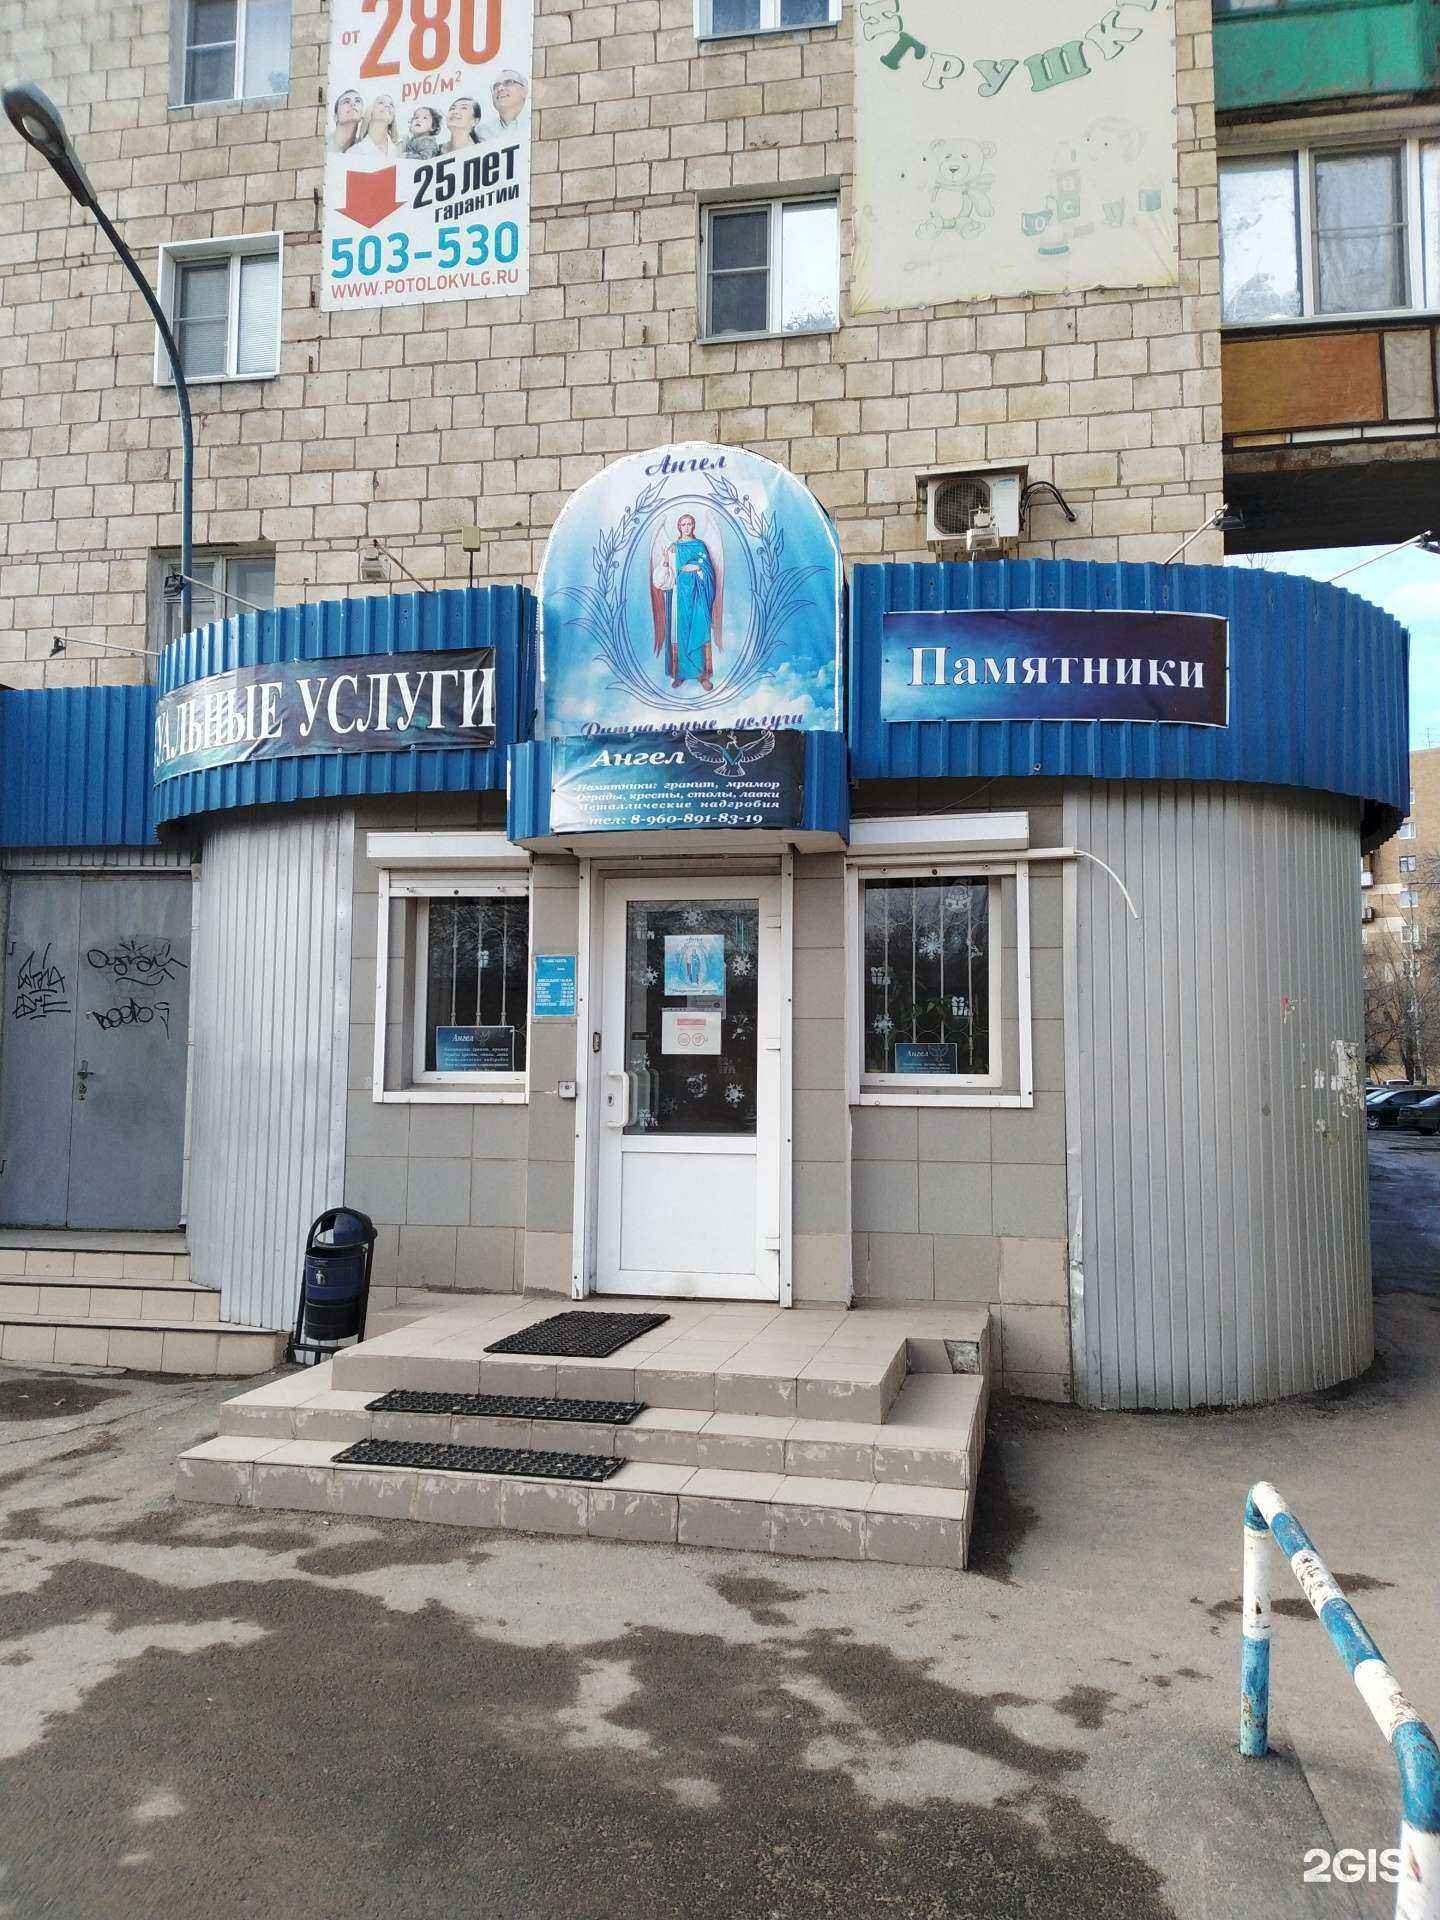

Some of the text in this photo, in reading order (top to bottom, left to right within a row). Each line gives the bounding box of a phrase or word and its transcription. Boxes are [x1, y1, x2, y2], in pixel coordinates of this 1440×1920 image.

[359, 0, 502, 79] 280
[413, 144, 521, 209] 25 лет
[434, 183, 520, 223] гарантии
[330, 220, 520, 279] 503-530
[331, 268, 519, 299] WWW.POTOLOKVLG.RU
[645, 454, 728, 477] Ангел
[907, 646, 1206, 690] Памятники
[295, 667, 497, 738] УСЛУГИ
[589, 749, 687, 768] Ангел
[726, 780, 781, 790] мрамор
[740, 790, 781, 799] лавки
[630, 812, 764, 826] 8-960-891-83-19
[700, 799, 781, 810] надгробия
